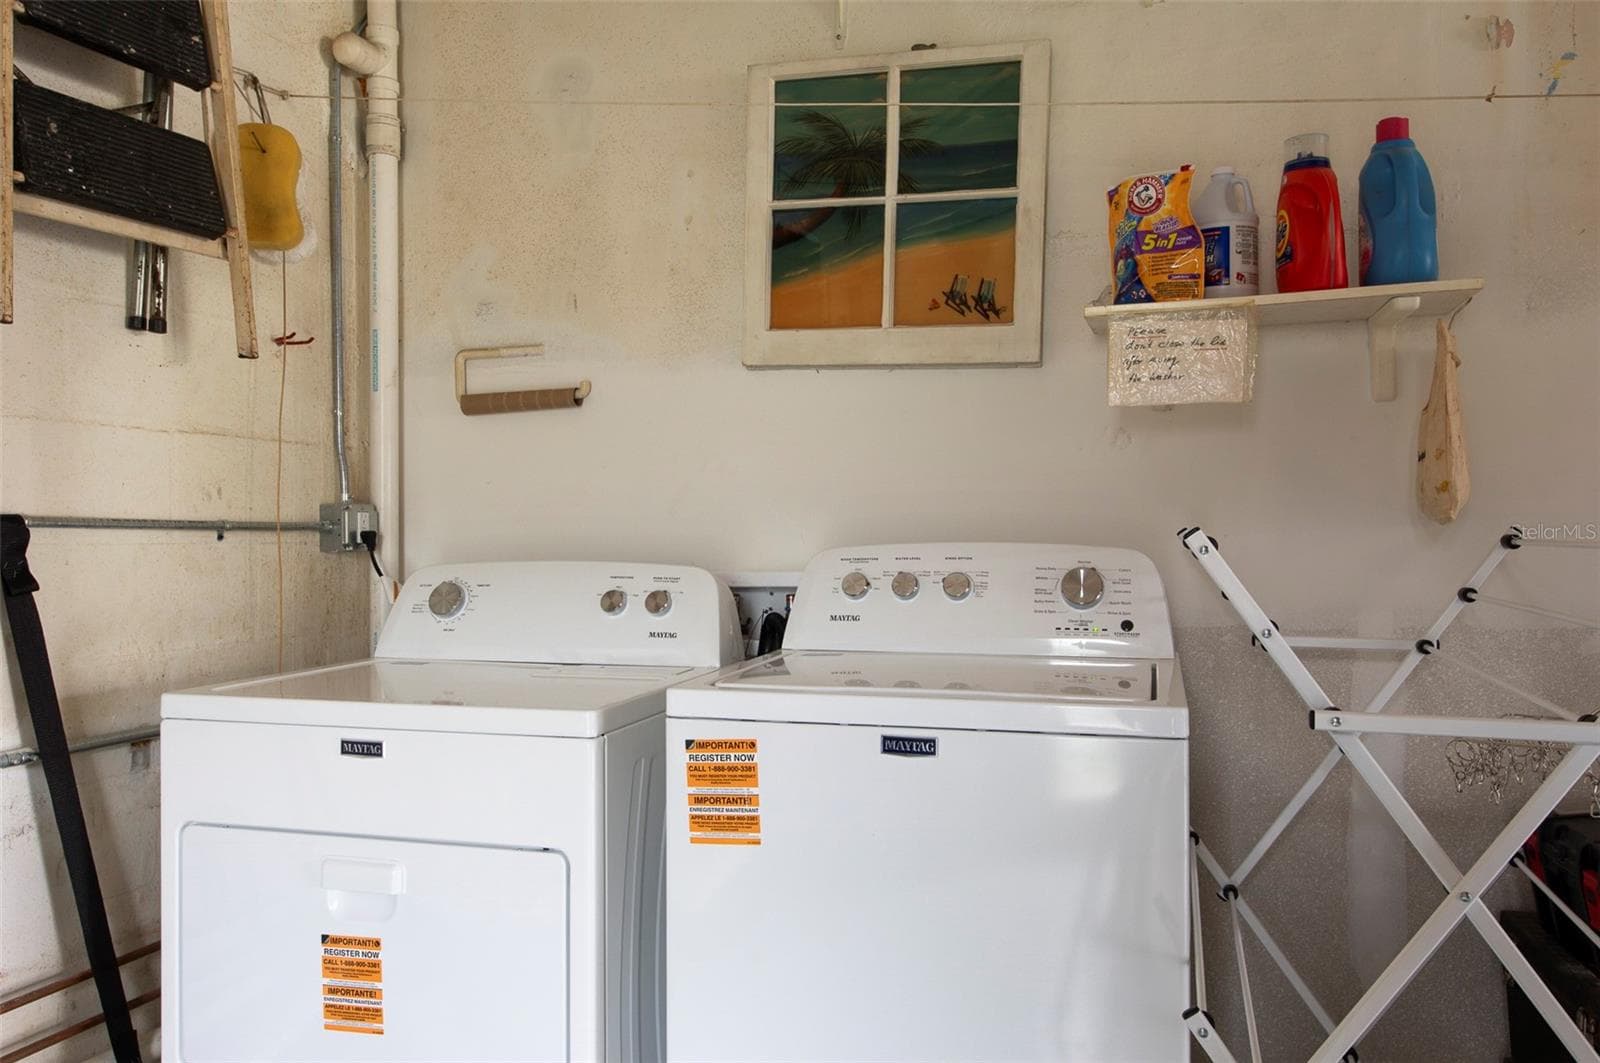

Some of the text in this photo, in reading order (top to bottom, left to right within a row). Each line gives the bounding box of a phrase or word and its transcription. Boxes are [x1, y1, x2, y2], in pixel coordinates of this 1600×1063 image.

[829, 614, 860, 622] MAYTAG
[648, 631, 678, 639] MAYTAG
[343, 743, 381, 754] MAYTAG
[695, 741, 748, 750] IMPORTANT!
[884, 740, 935, 752] MAYTAG
[688, 753, 755, 762] REGISTER NOW
[694, 796, 752, 805] IMPORTANTE!
[329, 938, 374, 948] IMPORTANT!
[323, 948, 380, 959] REGISTER NOW
[327, 987, 377, 998] IMPORTANTE!
